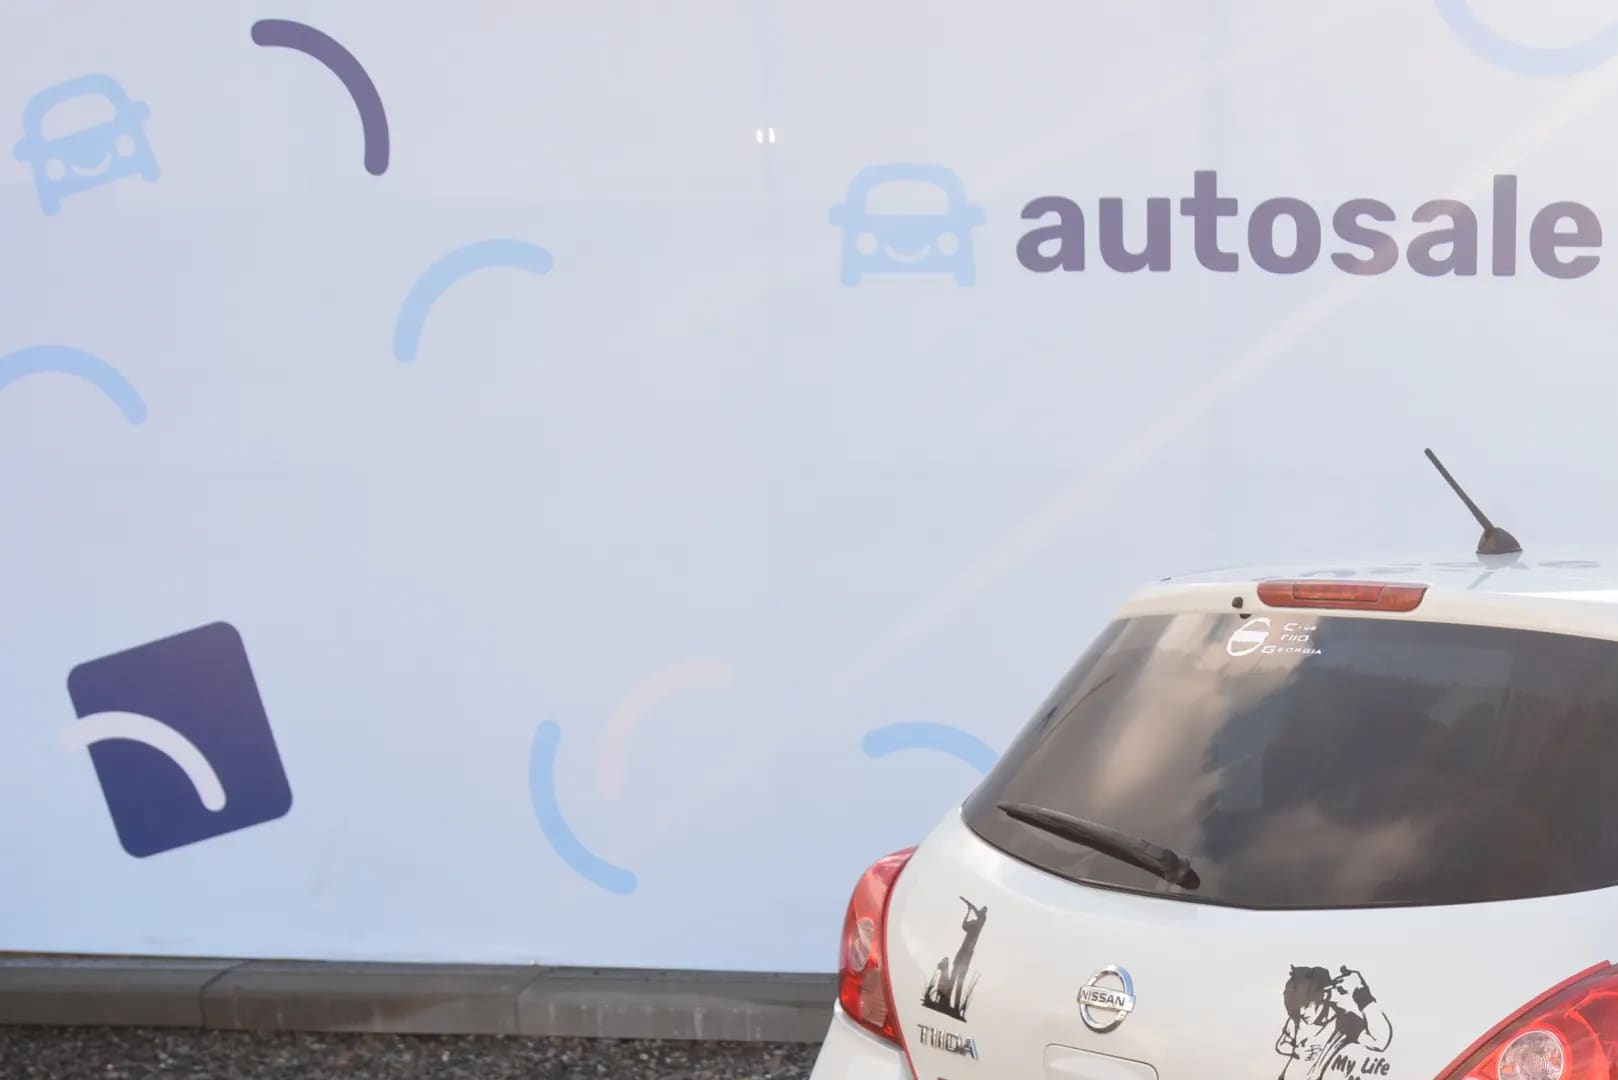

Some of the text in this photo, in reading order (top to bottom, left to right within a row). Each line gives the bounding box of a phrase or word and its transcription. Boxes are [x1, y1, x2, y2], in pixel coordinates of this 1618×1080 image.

[1015, 169, 1603, 280] autosale
[1080, 989, 1126, 1007] NISSAN
[917, 1023, 979, 1061] TIIDA
[1331, 1054, 1391, 1076] My Life
